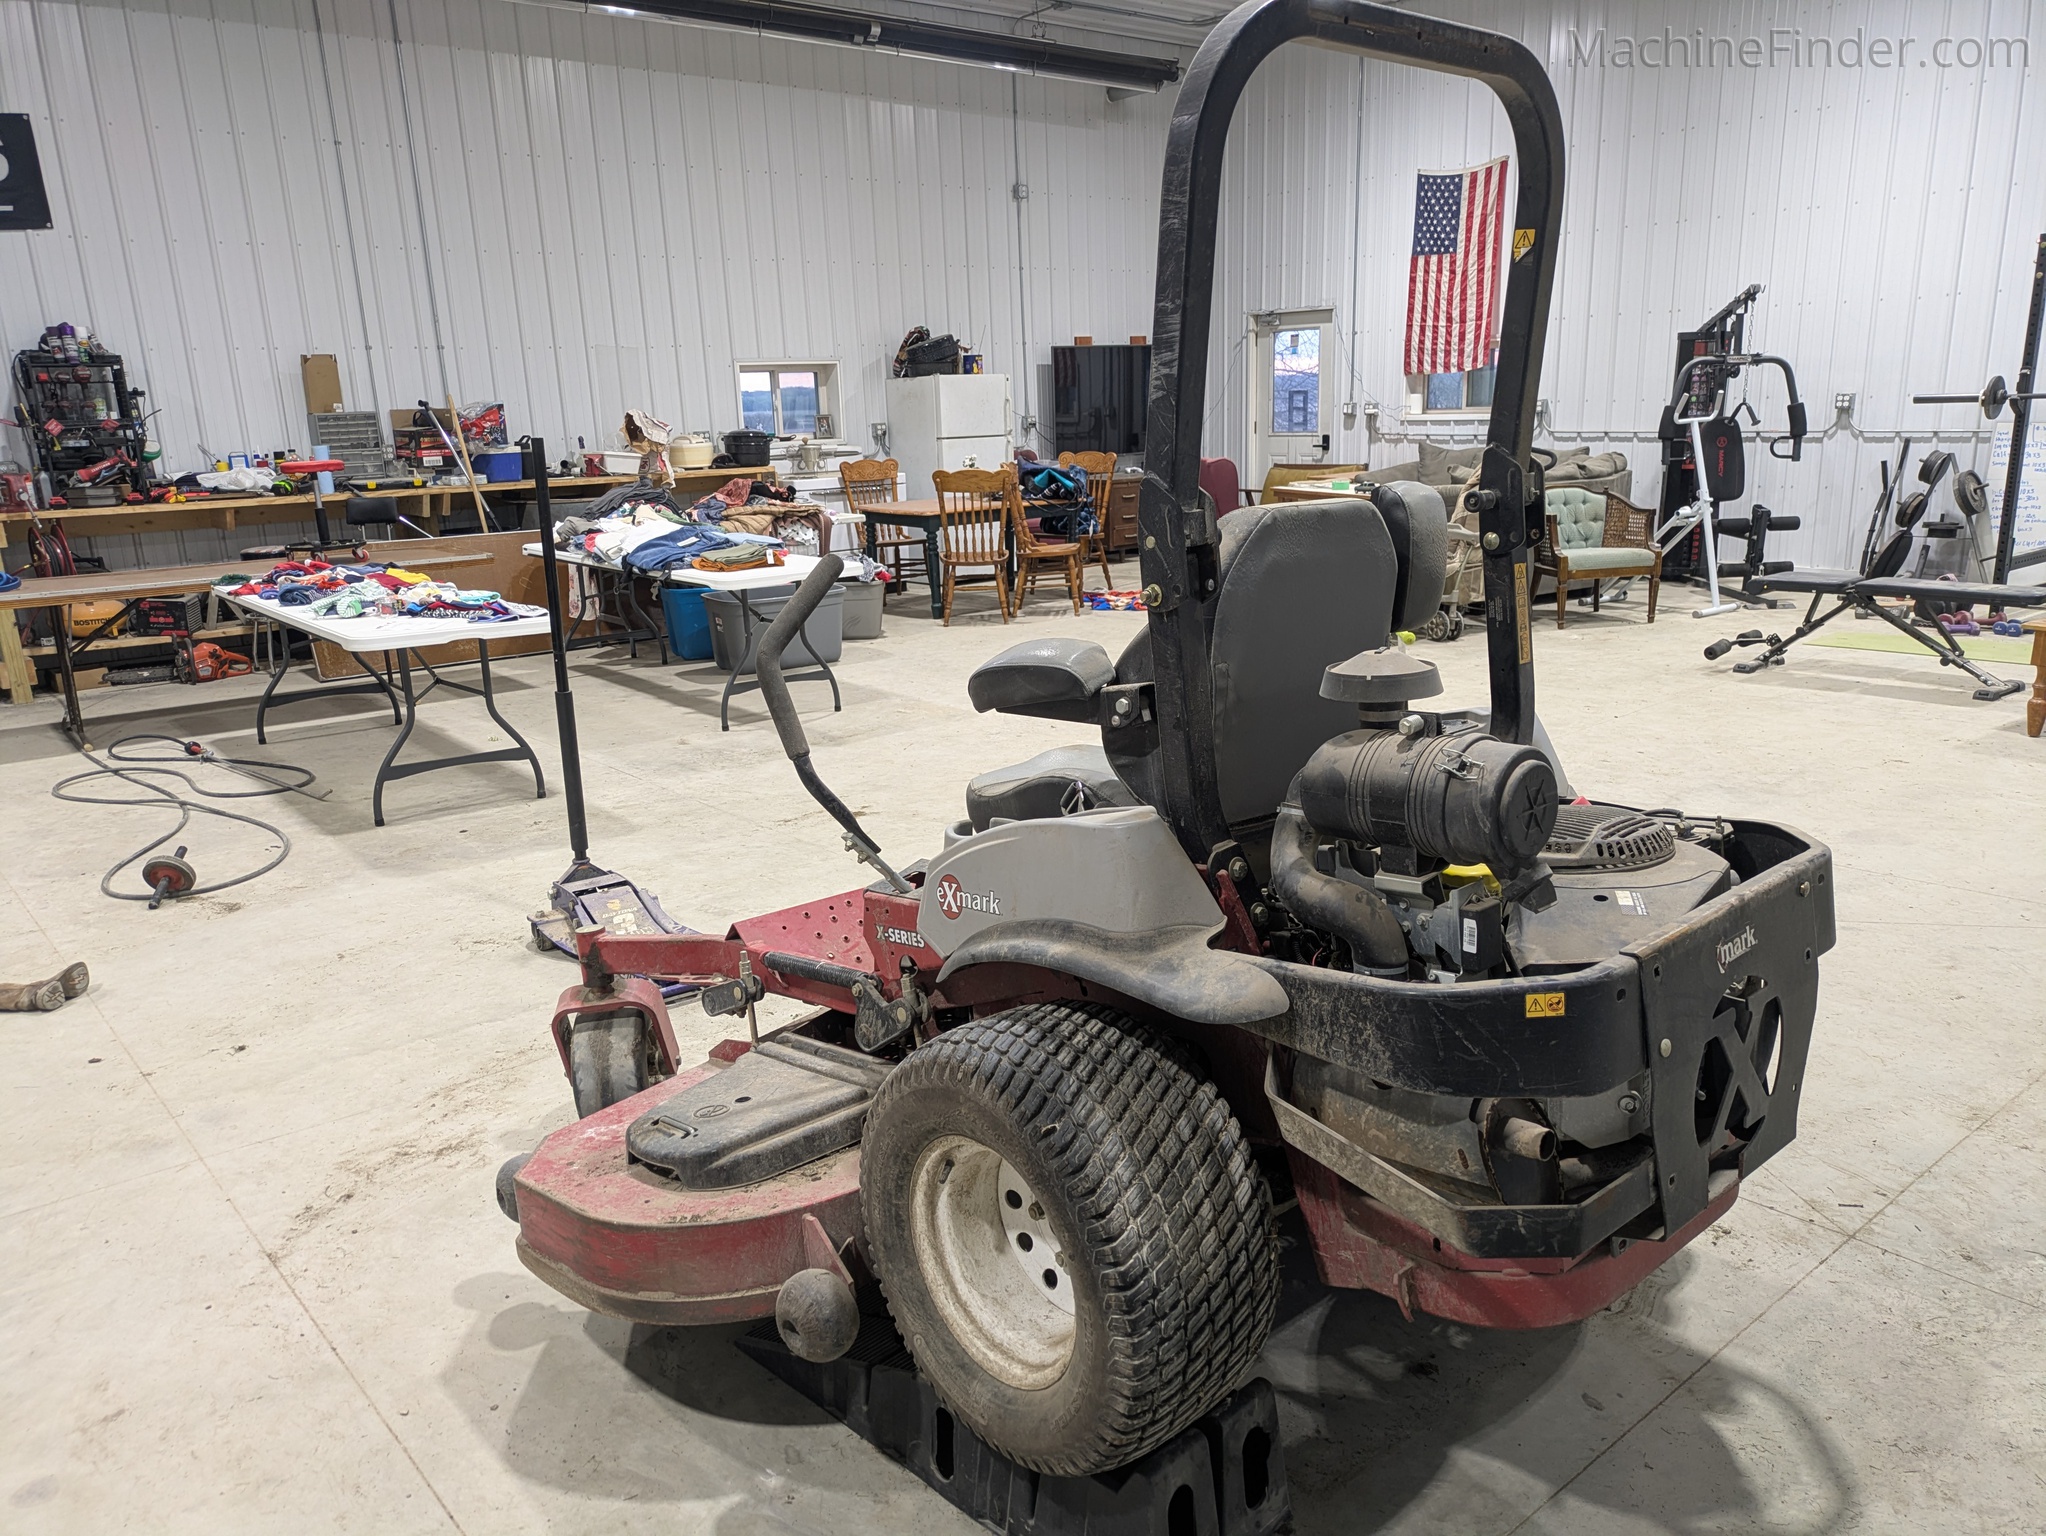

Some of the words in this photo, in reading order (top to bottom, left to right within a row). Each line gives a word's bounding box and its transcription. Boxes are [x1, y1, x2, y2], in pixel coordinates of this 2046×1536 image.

[1717, 450, 1725, 477] MARCY
[936, 880, 1001, 916] eXmark
[875, 924, 926, 949] X-SERIES
